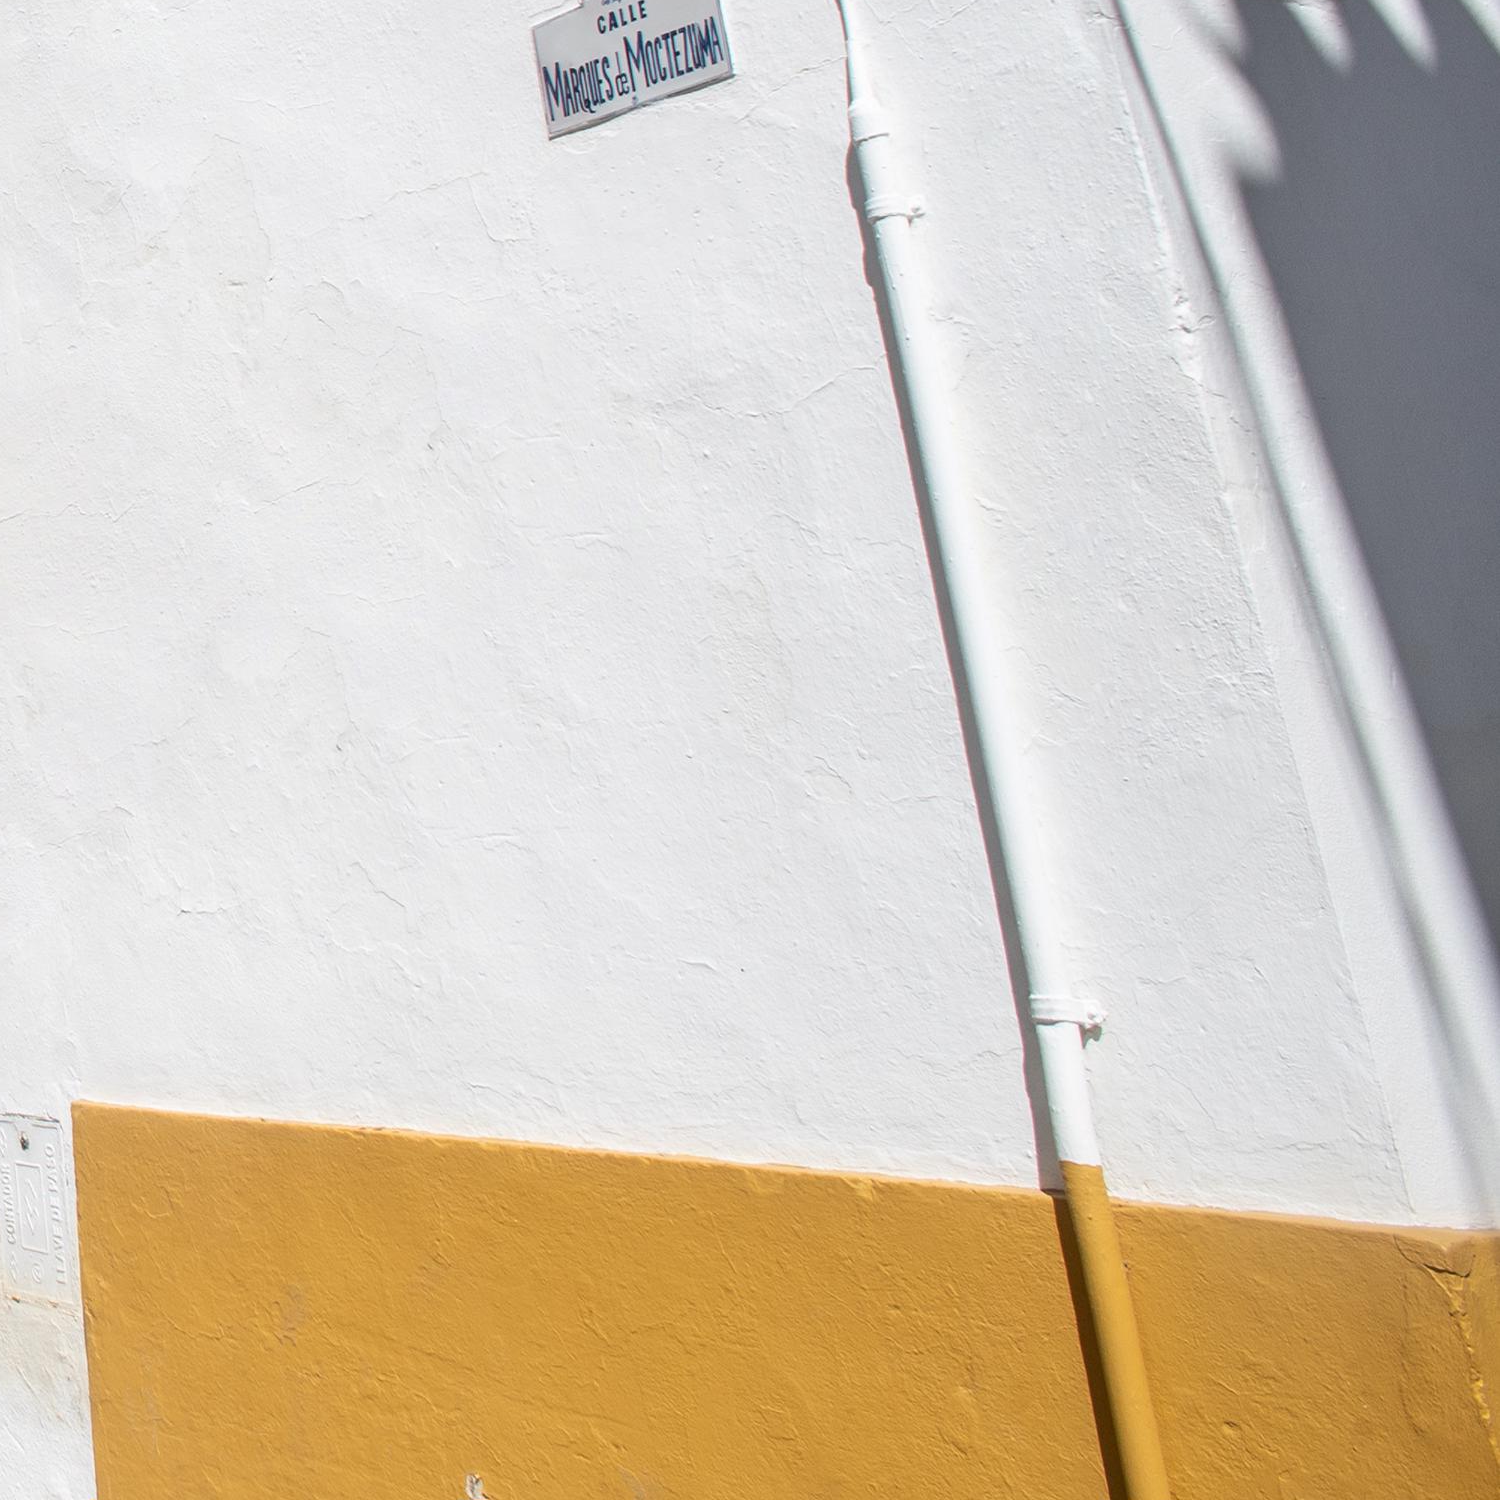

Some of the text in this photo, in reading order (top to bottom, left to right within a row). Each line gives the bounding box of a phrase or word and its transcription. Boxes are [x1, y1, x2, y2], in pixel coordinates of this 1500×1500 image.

[596, 0, 648, 34] CALLE
[542, 55, 614, 122] MARQUES
[623, 16, 724, 92] MOCTEZUMA
